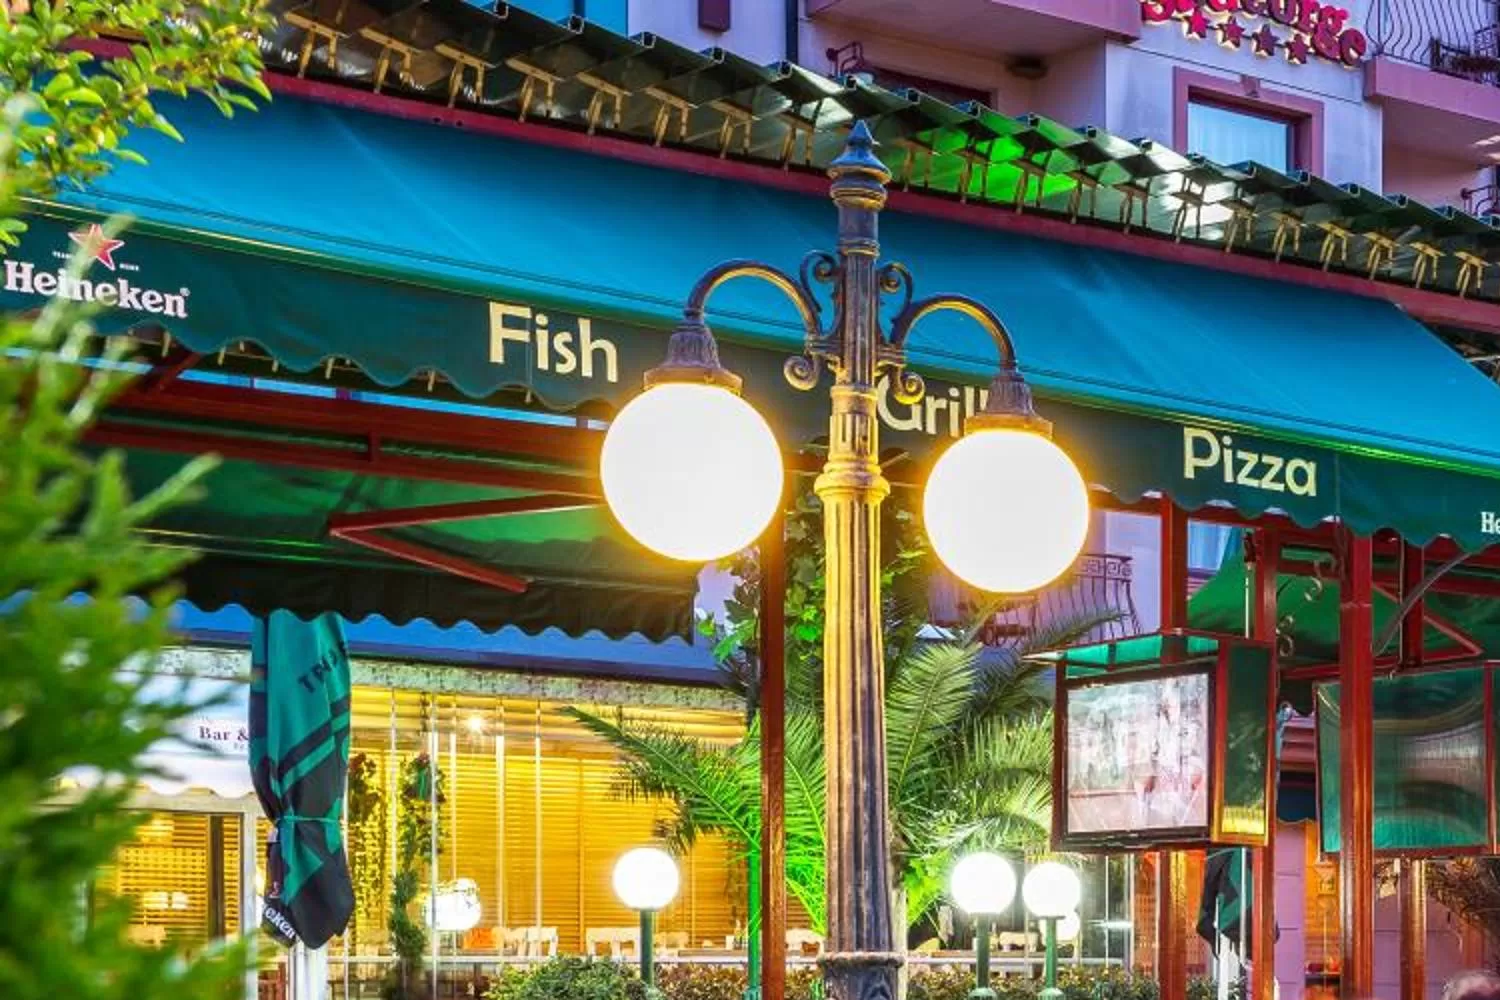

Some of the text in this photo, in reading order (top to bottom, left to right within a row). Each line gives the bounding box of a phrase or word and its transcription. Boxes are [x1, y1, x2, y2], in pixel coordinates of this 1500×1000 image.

[3, 259, 190, 319] Heineken
[489, 301, 618, 383] Fish
[1183, 426, 1317, 497] Pizza
[199, 725, 231, 741] Bar
